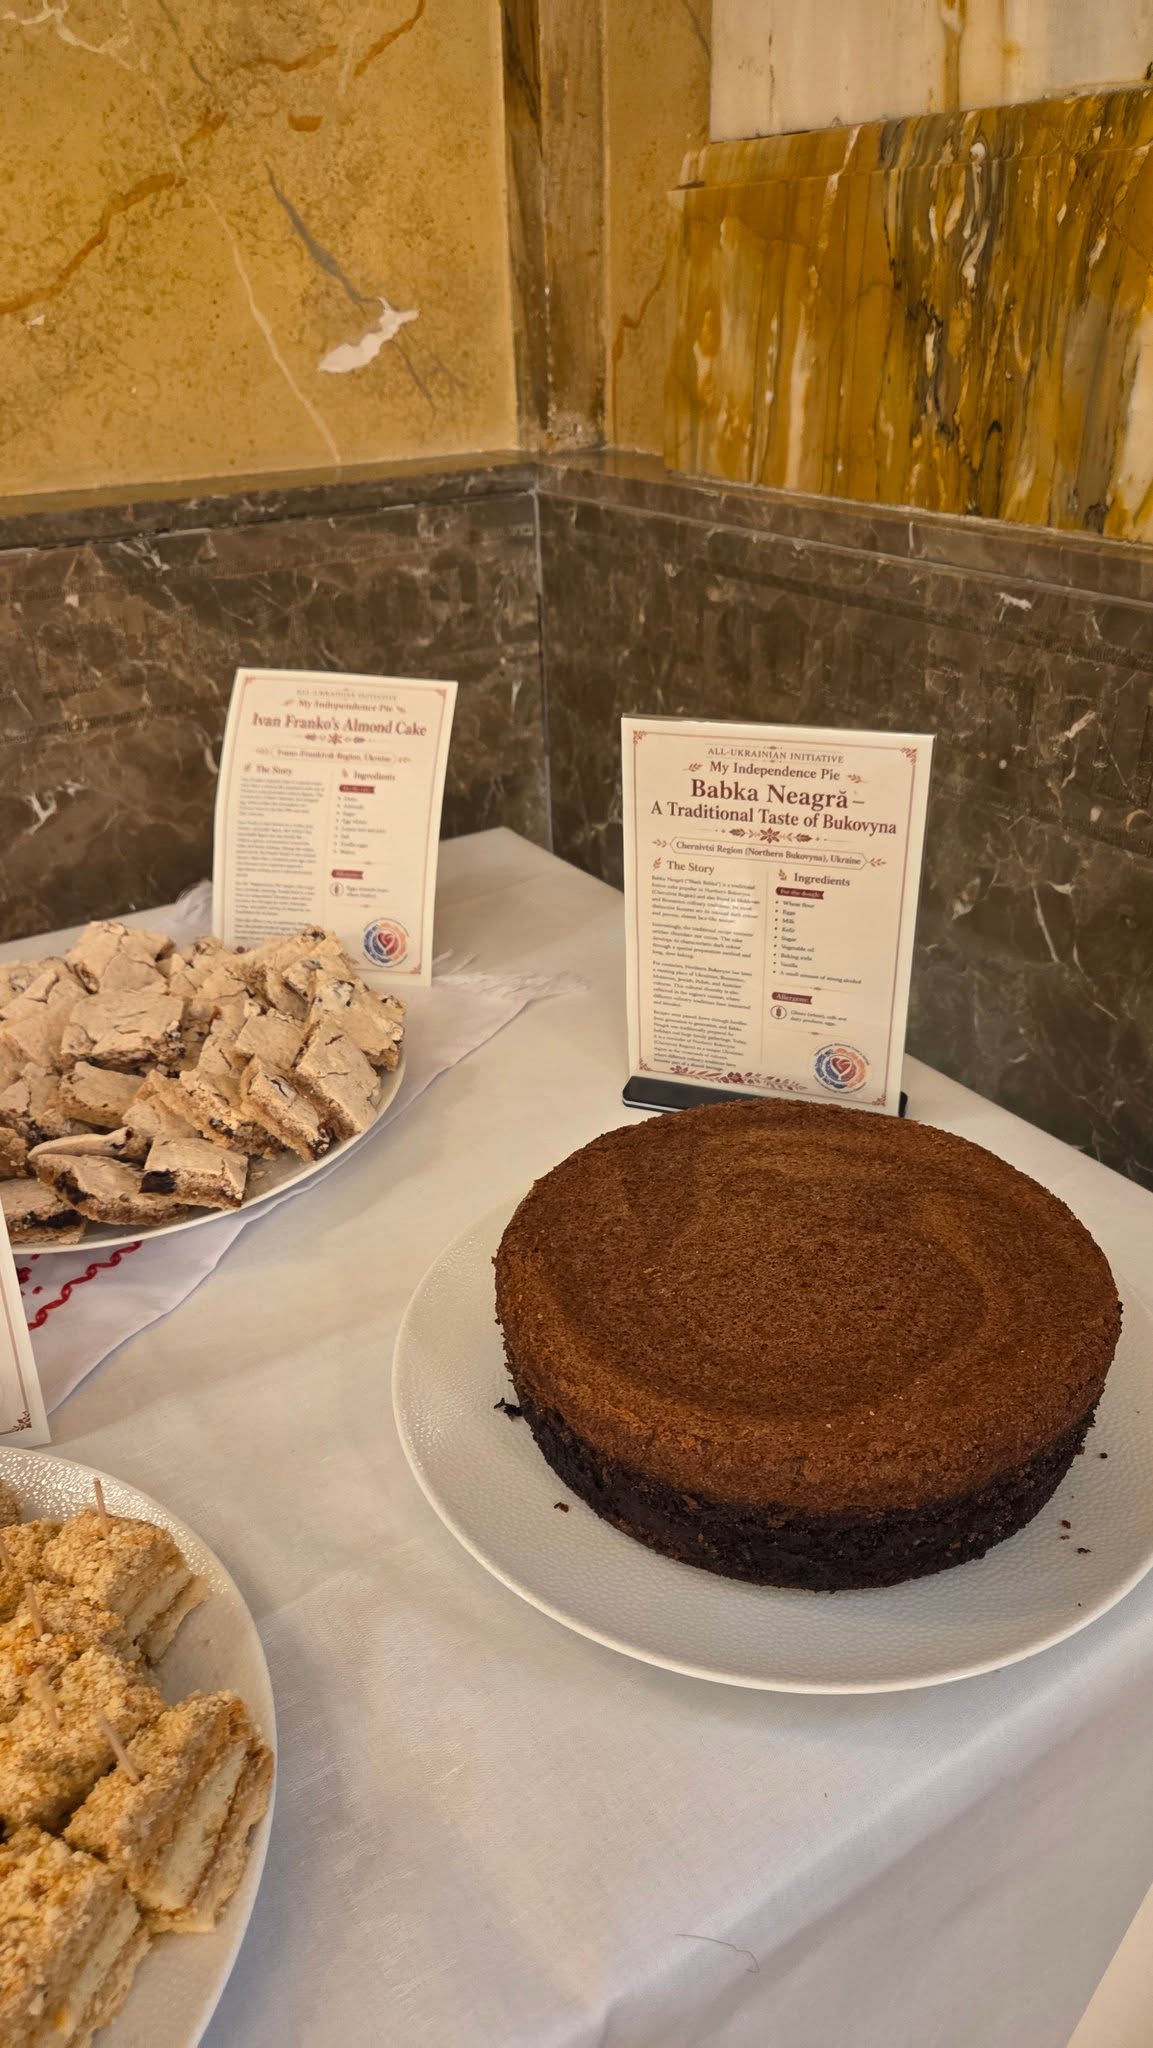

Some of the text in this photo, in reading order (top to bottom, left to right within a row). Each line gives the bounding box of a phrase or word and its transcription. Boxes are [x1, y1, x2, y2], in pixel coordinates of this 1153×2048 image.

[252, 712, 427, 737] Ivan Franko's Almond Cake
[708, 747, 844, 764] ALL-UKRAINIAN INITIATIVE
[256, 765, 270, 774] The
[354, 770, 395, 781] Ingredients
[710, 761, 840, 780] My Independence Pie
[691, 778, 759, 801] Babka
[767, 784, 848, 811] Neagră
[651, 800, 896, 836] A Traditional Taste of Bukovyna
[676, 840, 861, 865] Chernivtsi Region (Northern Bukovyna), Ukraine
[667, 860, 714, 876] The Story
[794, 873, 850, 886] Ingredients
